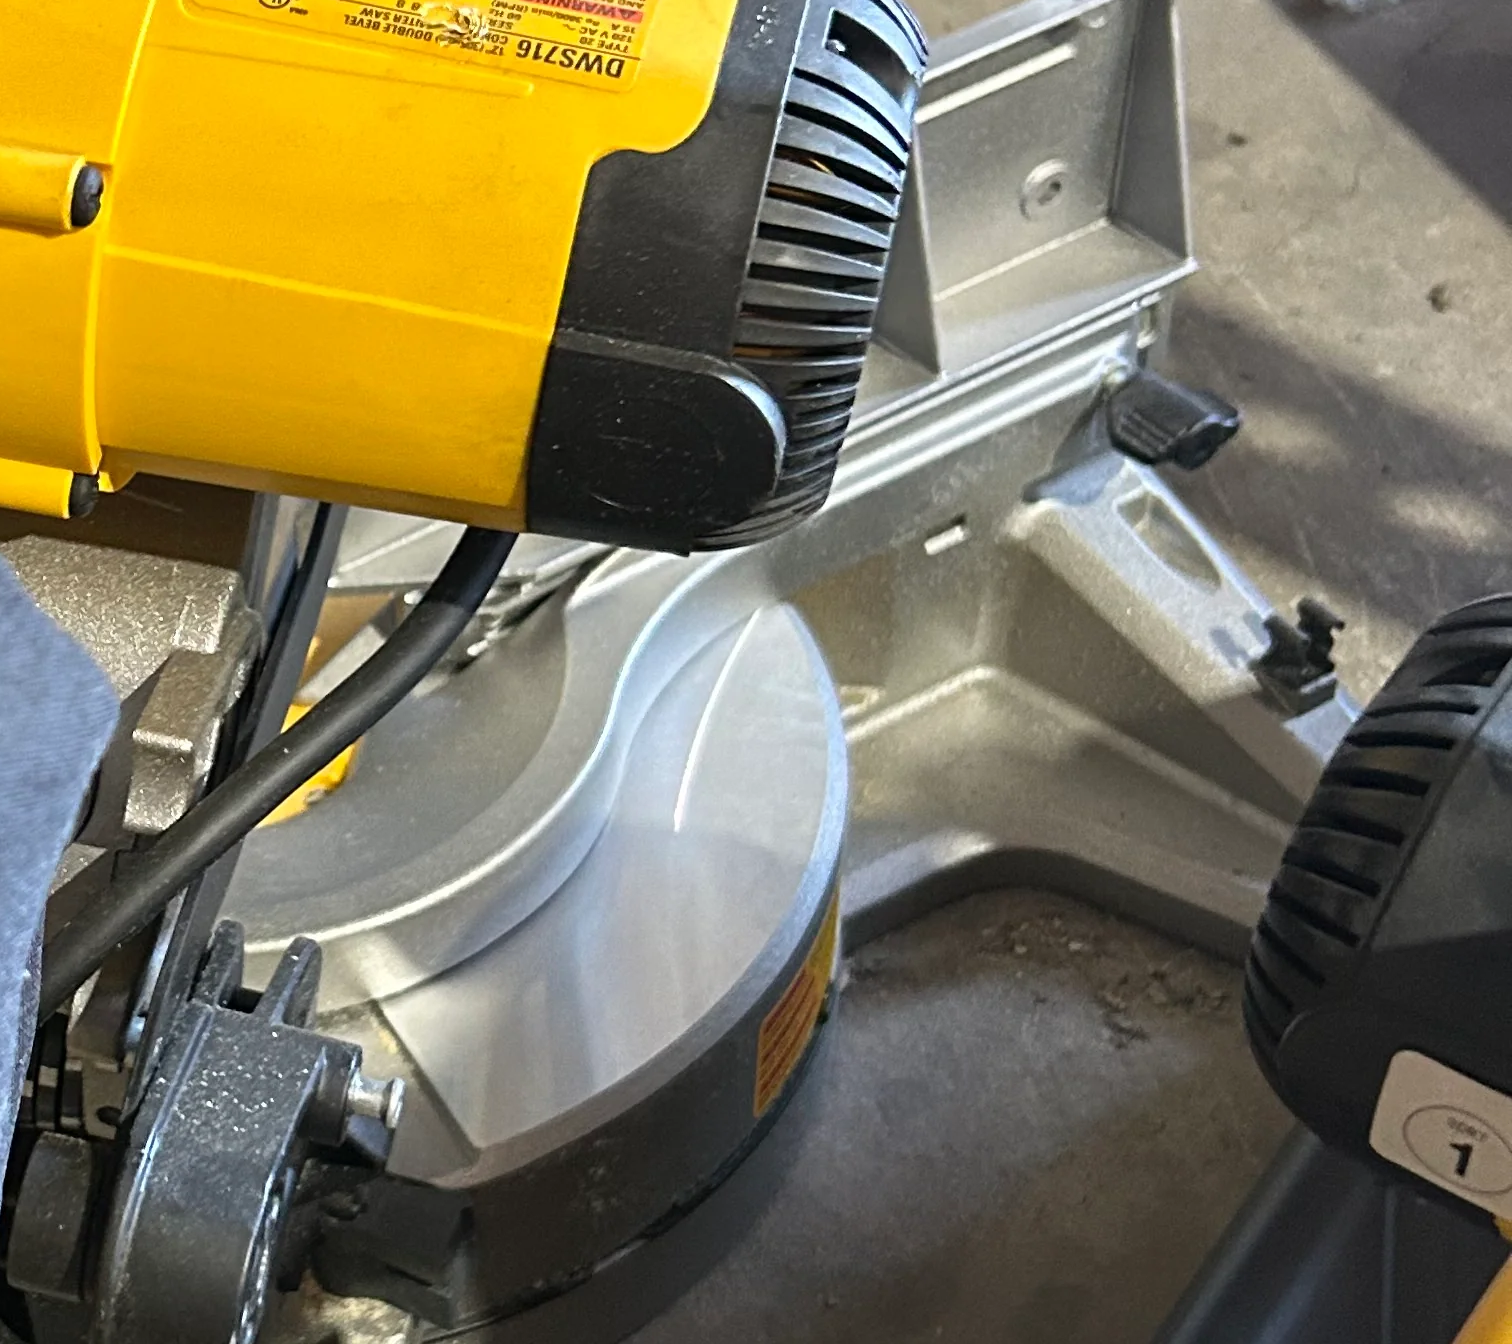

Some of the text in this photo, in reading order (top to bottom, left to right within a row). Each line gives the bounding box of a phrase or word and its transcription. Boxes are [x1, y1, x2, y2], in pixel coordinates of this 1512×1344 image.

[358, 6, 392, 20] SAW
[340, 13, 382, 30] BEVEL
[577, 26, 598, 36] AC
[599, 30, 609, 38] V
[595, 39, 630, 53] TYPE
[511, 38, 626, 79] DWS716
[1449, 1142, 1474, 1178] 1
